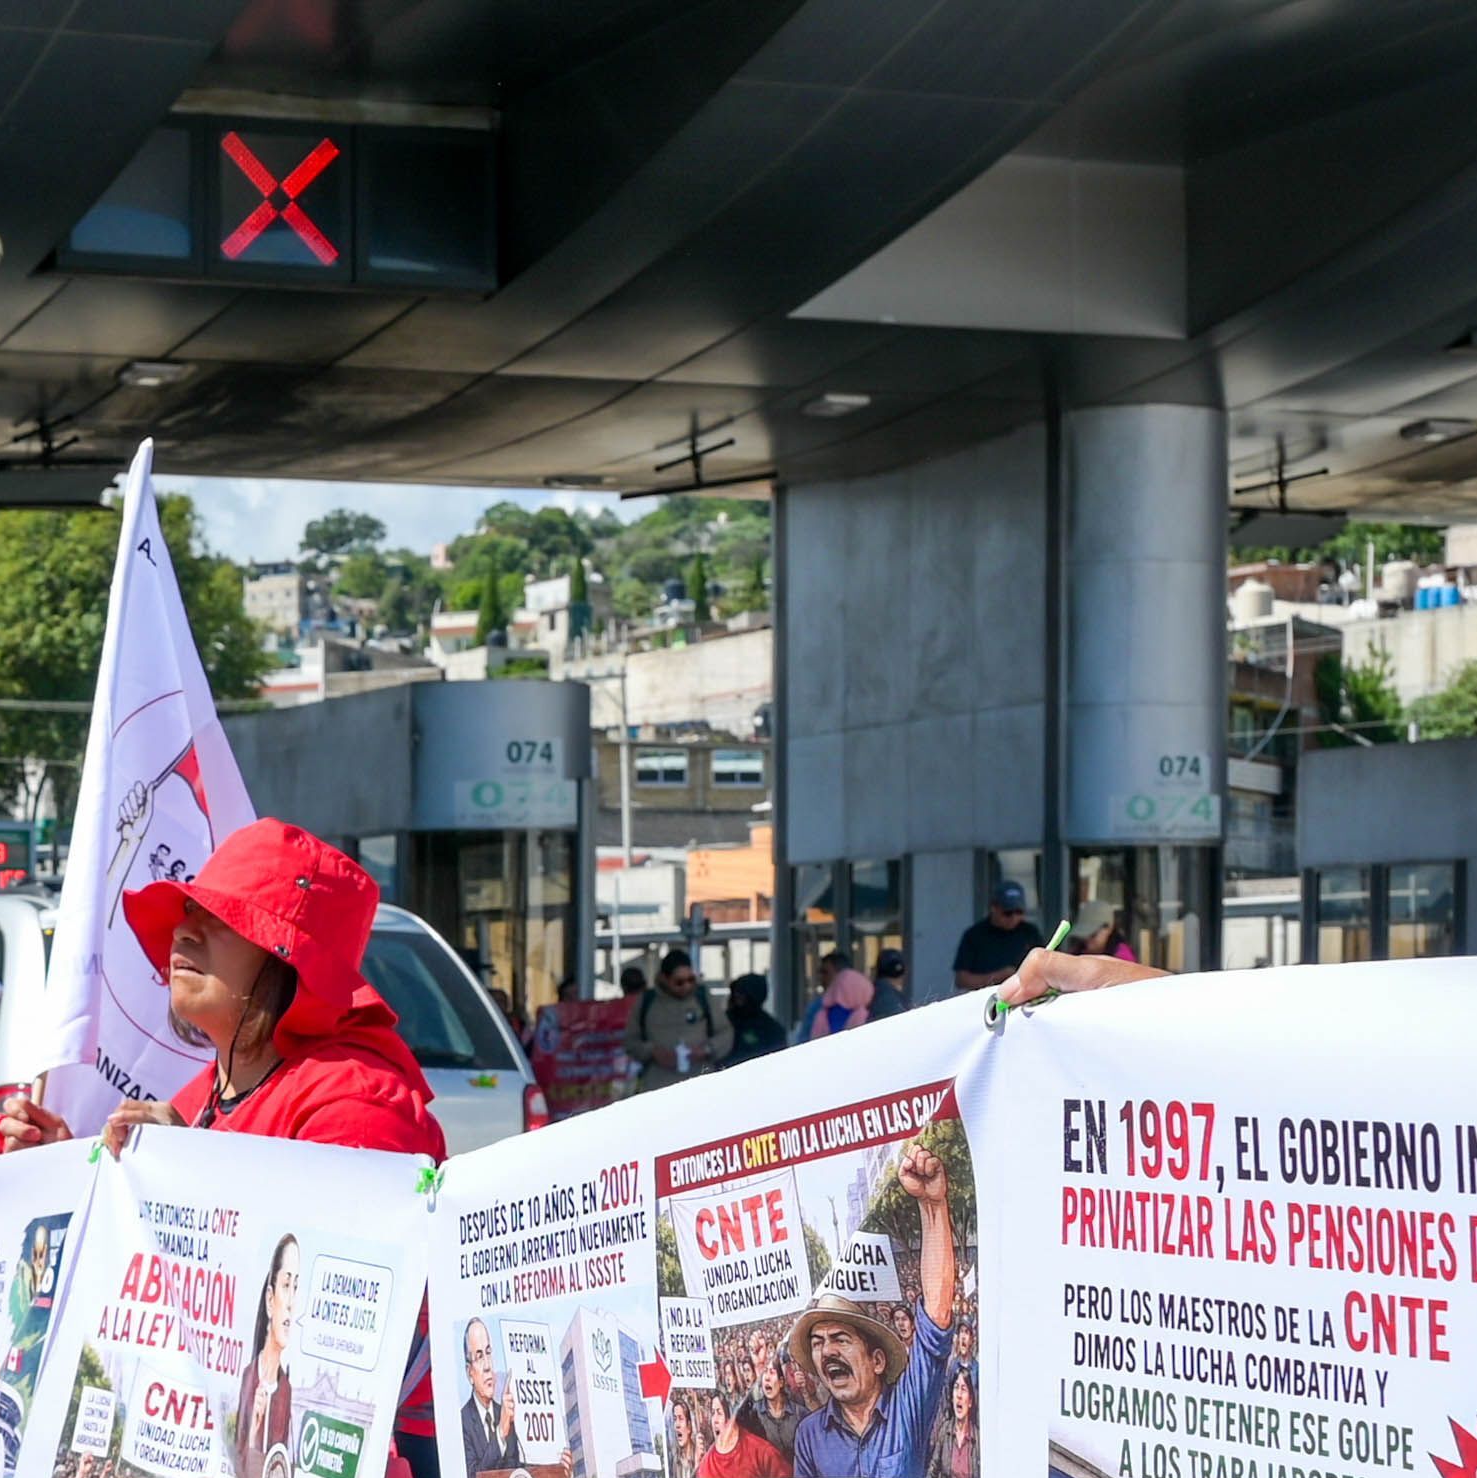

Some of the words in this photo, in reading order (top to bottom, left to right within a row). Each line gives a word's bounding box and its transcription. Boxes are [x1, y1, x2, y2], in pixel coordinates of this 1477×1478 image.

[506, 741, 553, 763] 074
[1160, 756, 1200, 776] 074
[1126, 795, 1213, 820] 074
[670, 1150, 724, 1187] ENTONCES
[725, 1144, 742, 1173] LA
[742, 1132, 779, 1169] CNTE
[780, 1128, 800, 1160] DIO
[802, 1125, 818, 1154] LA
[821, 1112, 862, 1152] LUCHA
[864, 1106, 884, 1138] EN
[886, 1100, 912, 1134] LAS
[1063, 1098, 1107, 1175] EN
[1119, 1100, 1225, 1193] 1997,
[1236, 1116, 1268, 1181] EL
[1279, 1118, 1441, 1193] GOBIERNO
[460, 1200, 507, 1245] DESPUÉS
[511, 1200, 524, 1232] DE
[528, 1196, 540, 1228] 10
[544, 1184, 579, 1223] AÑOS,
[582, 1180, 597, 1215] EN
[600, 1161, 643, 1211] 2007,
[695, 1189, 788, 1261] CNTE
[1062, 1187, 1214, 1260] PRIVATIZAR
[1224, 1197, 1276, 1265] LAS
[1288, 1202, 1458, 1281] PENSIONES
[461, 1255, 470, 1279] EL
[473, 1242, 518, 1276] GOBIERNO
[521, 1222, 576, 1266] ARREMETIÓ
[580, 1211, 647, 1252] NUEVAMENTE
[481, 1283, 497, 1308] CON
[501, 1280, 511, 1304] LA
[514, 1265, 565, 1304] REFORMA
[570, 1262, 582, 1292] AL
[585, 1252, 625, 1289] ISSSTE
[1064, 1283, 1113, 1320] PERO
[1120, 1288, 1153, 1327] LOS
[1159, 1293, 1268, 1340] MAESTROS
[1275, 1306, 1300, 1344] DE
[1308, 1309, 1335, 1348] LA
[1344, 1290, 1450, 1362] CNTE
[1073, 1332, 1136, 1373] DIMOS
[1143, 1341, 1169, 1377] LA
[1172, 1344, 1238, 1386] LUCHA
[1245, 1353, 1367, 1402] COMBATIVA
[1376, 1371, 1388, 1408] Y
[1061, 1379, 1177, 1432] LOGRAMOS
[1185, 1396, 1279, 1449] DETENER
[1290, 1411, 1329, 1456] ESE
[1338, 1418, 1414, 1470] GOLPE
[1119, 1438, 1133, 1477] A
